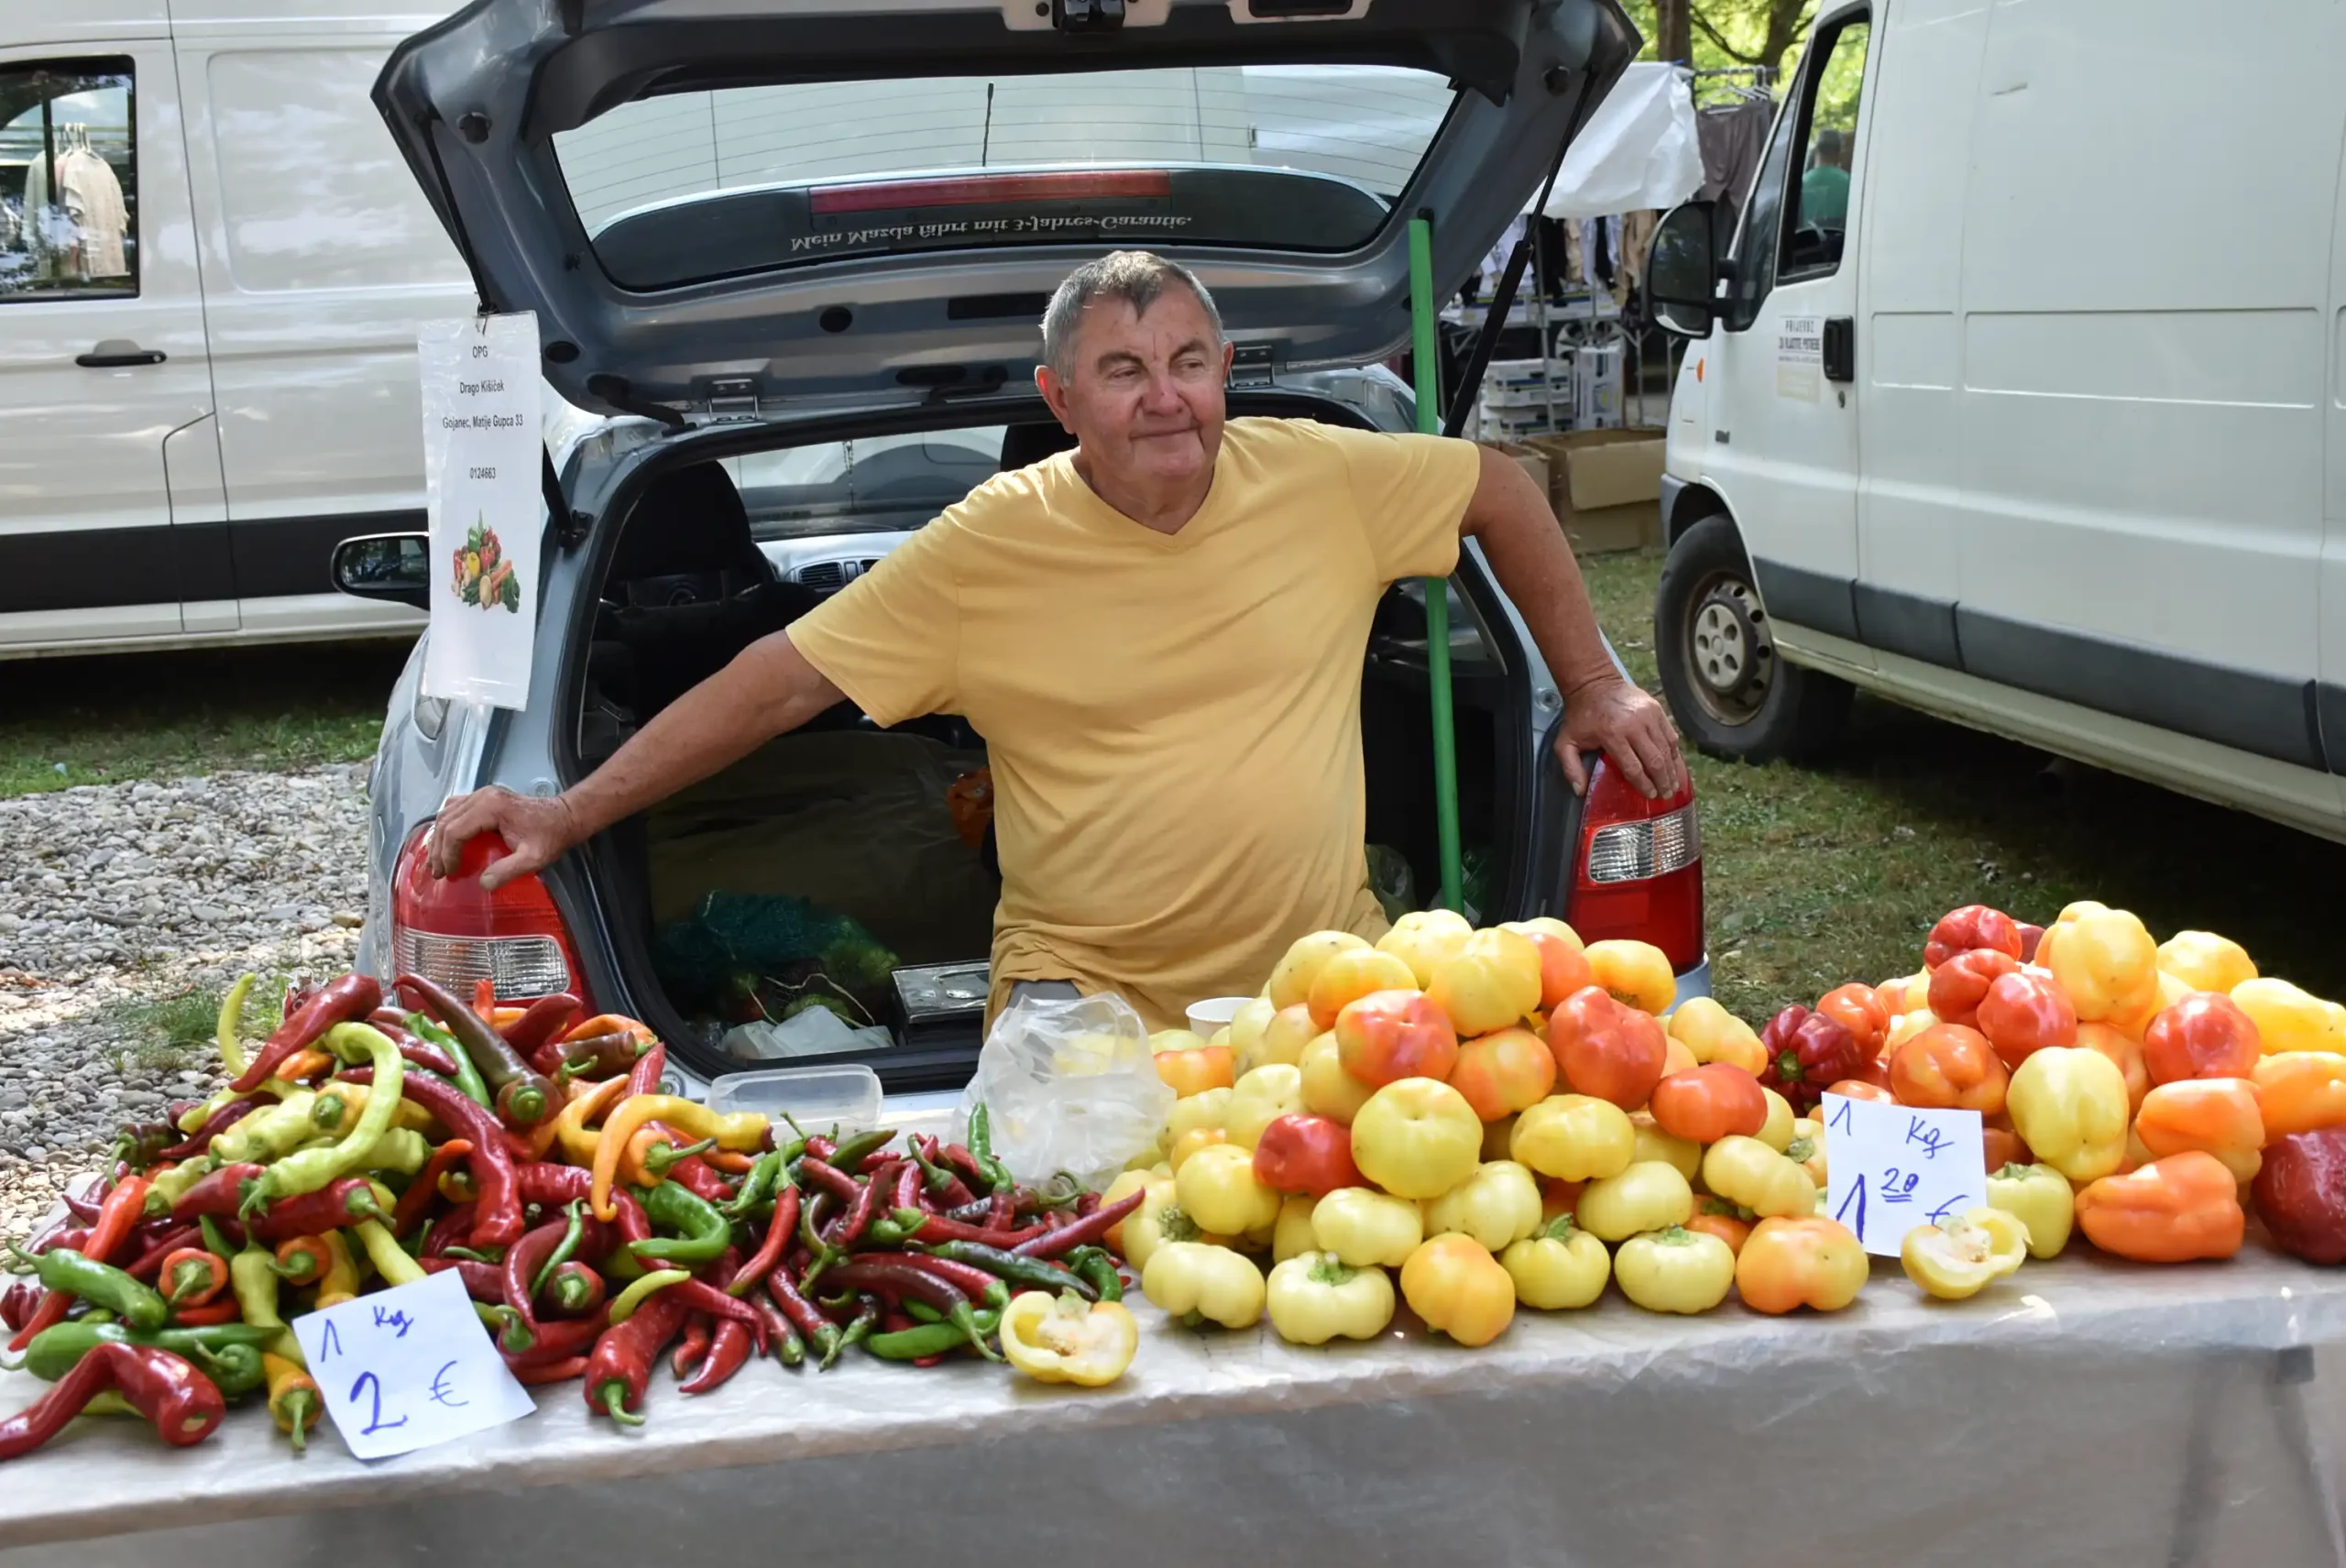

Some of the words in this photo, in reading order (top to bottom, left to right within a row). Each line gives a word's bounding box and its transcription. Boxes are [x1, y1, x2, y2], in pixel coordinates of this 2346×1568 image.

[472, 345, 488, 358] OPG
[459, 382, 480, 396] Drago
[443, 416, 471, 431] Gojanec,
[472, 415, 491, 430] Matije
[493, 415, 514, 429] Gupca
[515, 414, 523, 426] 33
[469, 467, 496, 479] 0124663
[1829, 1100, 1851, 1136] 1
[321, 1319, 343, 1363] 1
[349, 1371, 409, 1435] 2
[429, 1360, 469, 1407] €
